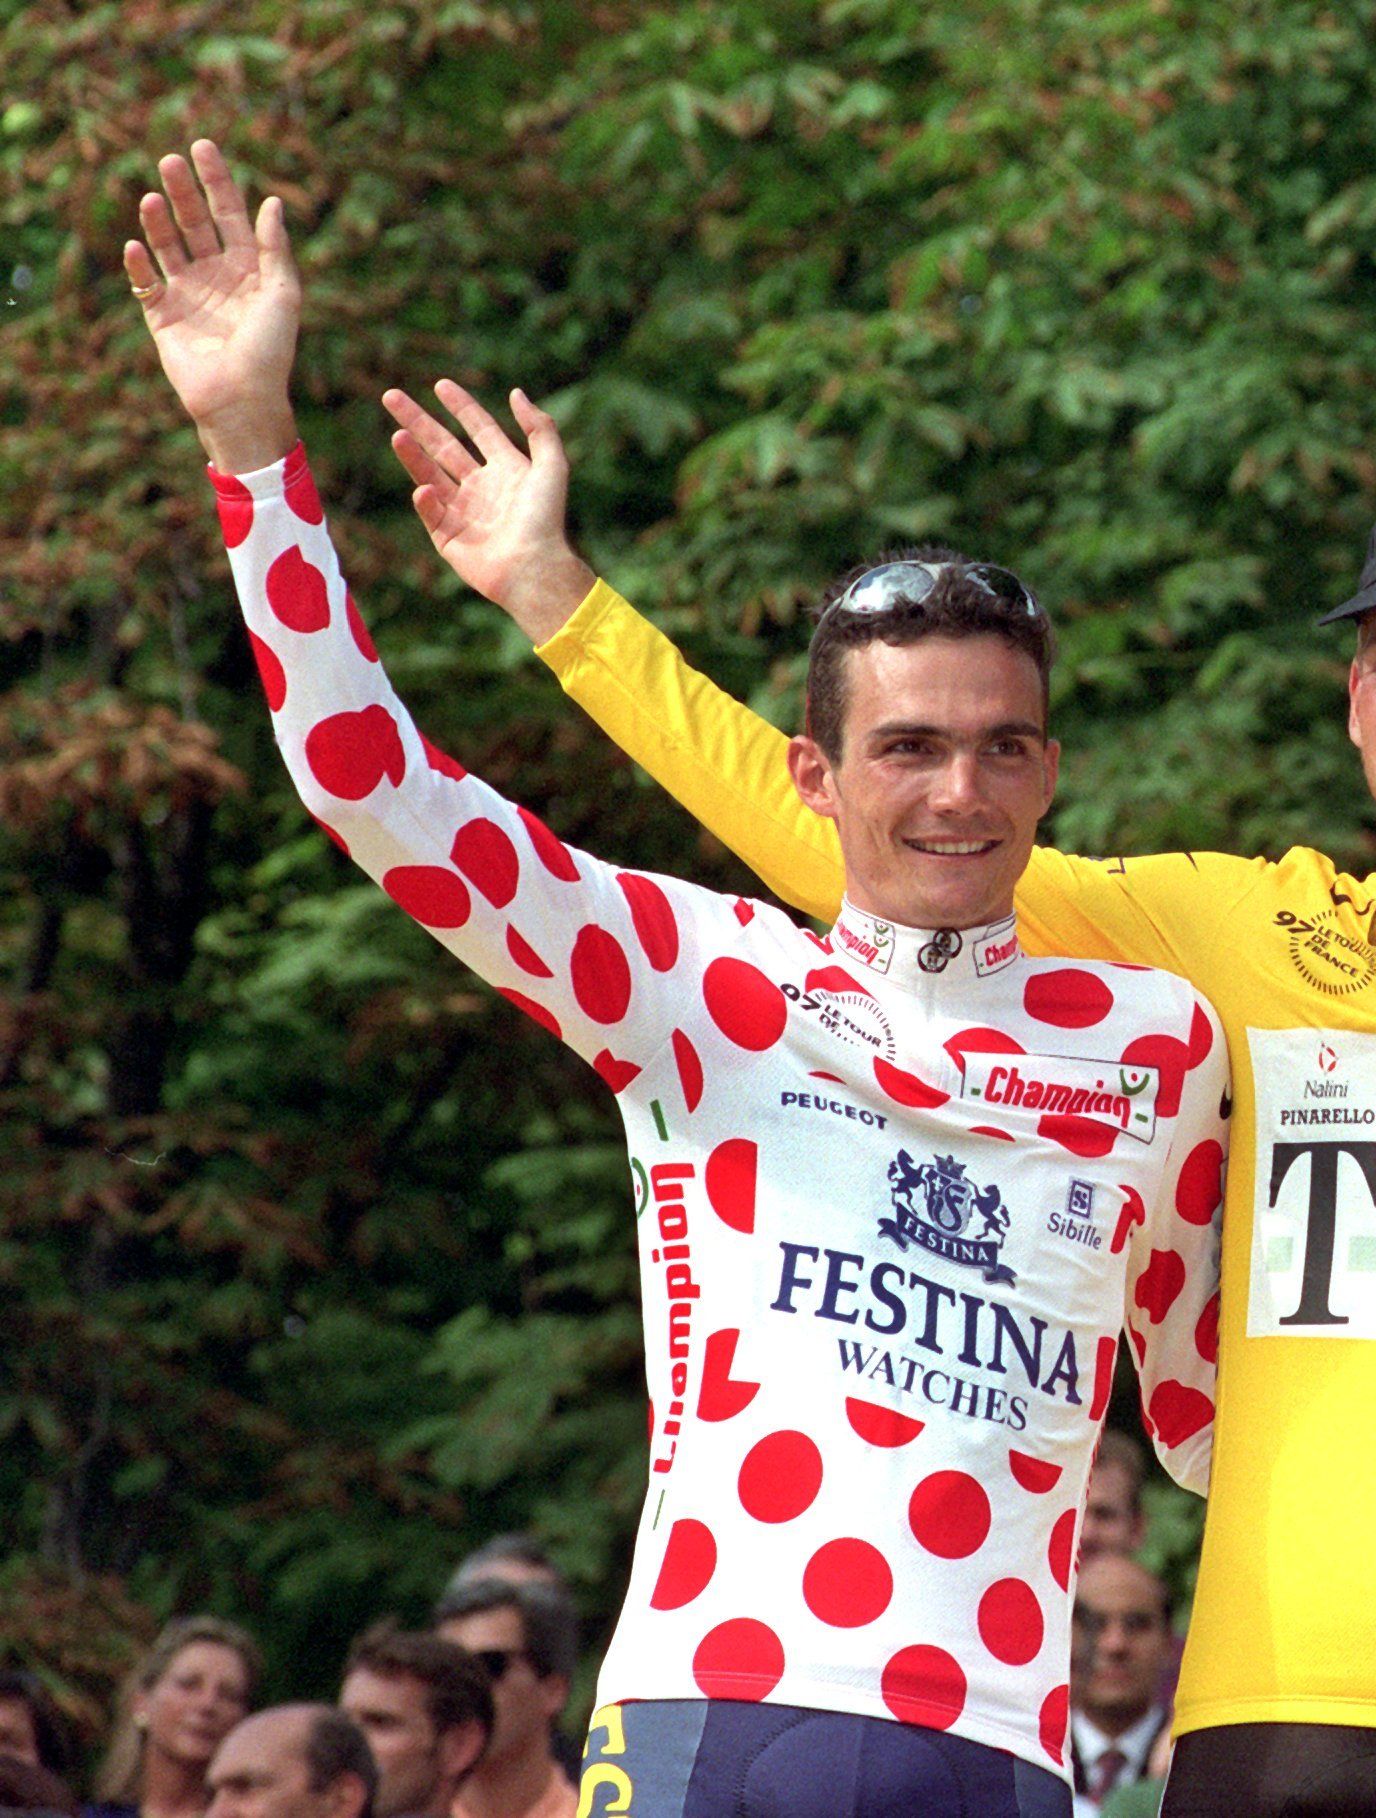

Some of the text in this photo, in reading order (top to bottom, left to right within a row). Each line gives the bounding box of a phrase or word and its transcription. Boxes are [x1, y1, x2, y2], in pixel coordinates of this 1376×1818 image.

[1273, 911, 1315, 934] 97
[1311, 934, 1330, 948] DE
[1317, 925, 1331, 938] LE
[1304, 940, 1359, 977] FRANCE
[824, 1004, 841, 1020] LE
[844, 1016, 882, 1047] TOUR
[984, 1066, 1131, 1129] Champion
[1303, 1080, 1349, 1099] Nalini
[781, 1091, 888, 1130] PEUGEOT
[1281, 1109, 1376, 1126] PINARELLO
[905, 1215, 990, 1262] FESTINA
[1047, 1212, 1103, 1250] Sibille
[770, 1241, 1083, 1405] FESTINA
[837, 1338, 1029, 1431] WATCHES
